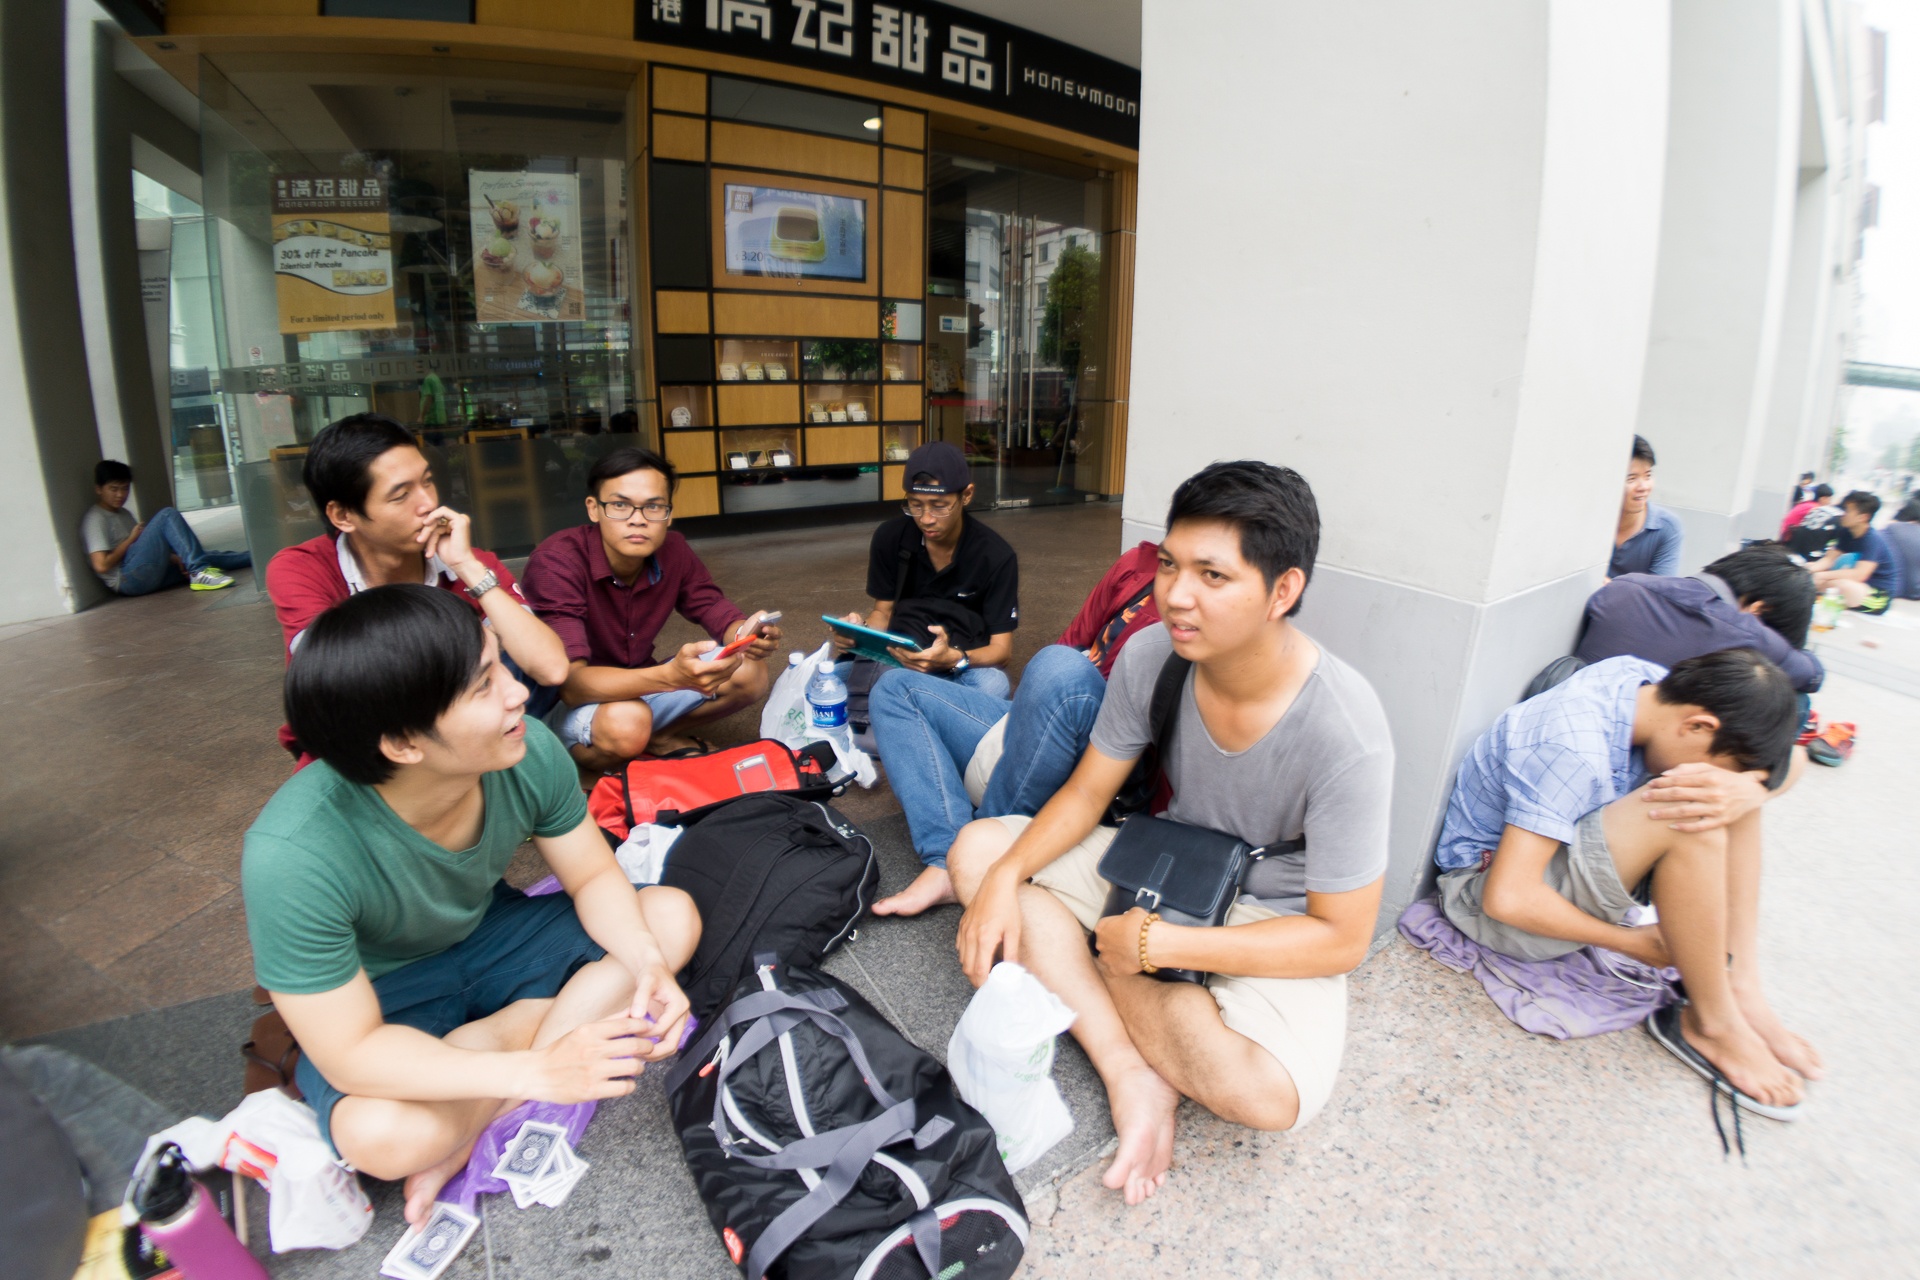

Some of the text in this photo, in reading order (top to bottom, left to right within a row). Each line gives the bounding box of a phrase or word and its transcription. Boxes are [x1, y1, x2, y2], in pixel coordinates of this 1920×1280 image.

[340, 200, 381, 208] DESSERT
[280, 249, 301, 260] 30%
[304, 248, 321, 259] off
[340, 248, 379, 258] Pancake
[279, 261, 343, 270] Identical Pancake
[290, 315, 305, 324] For
[312, 314, 340, 323] limited
[341, 313, 367, 324] period
[367, 312, 385, 322] only
